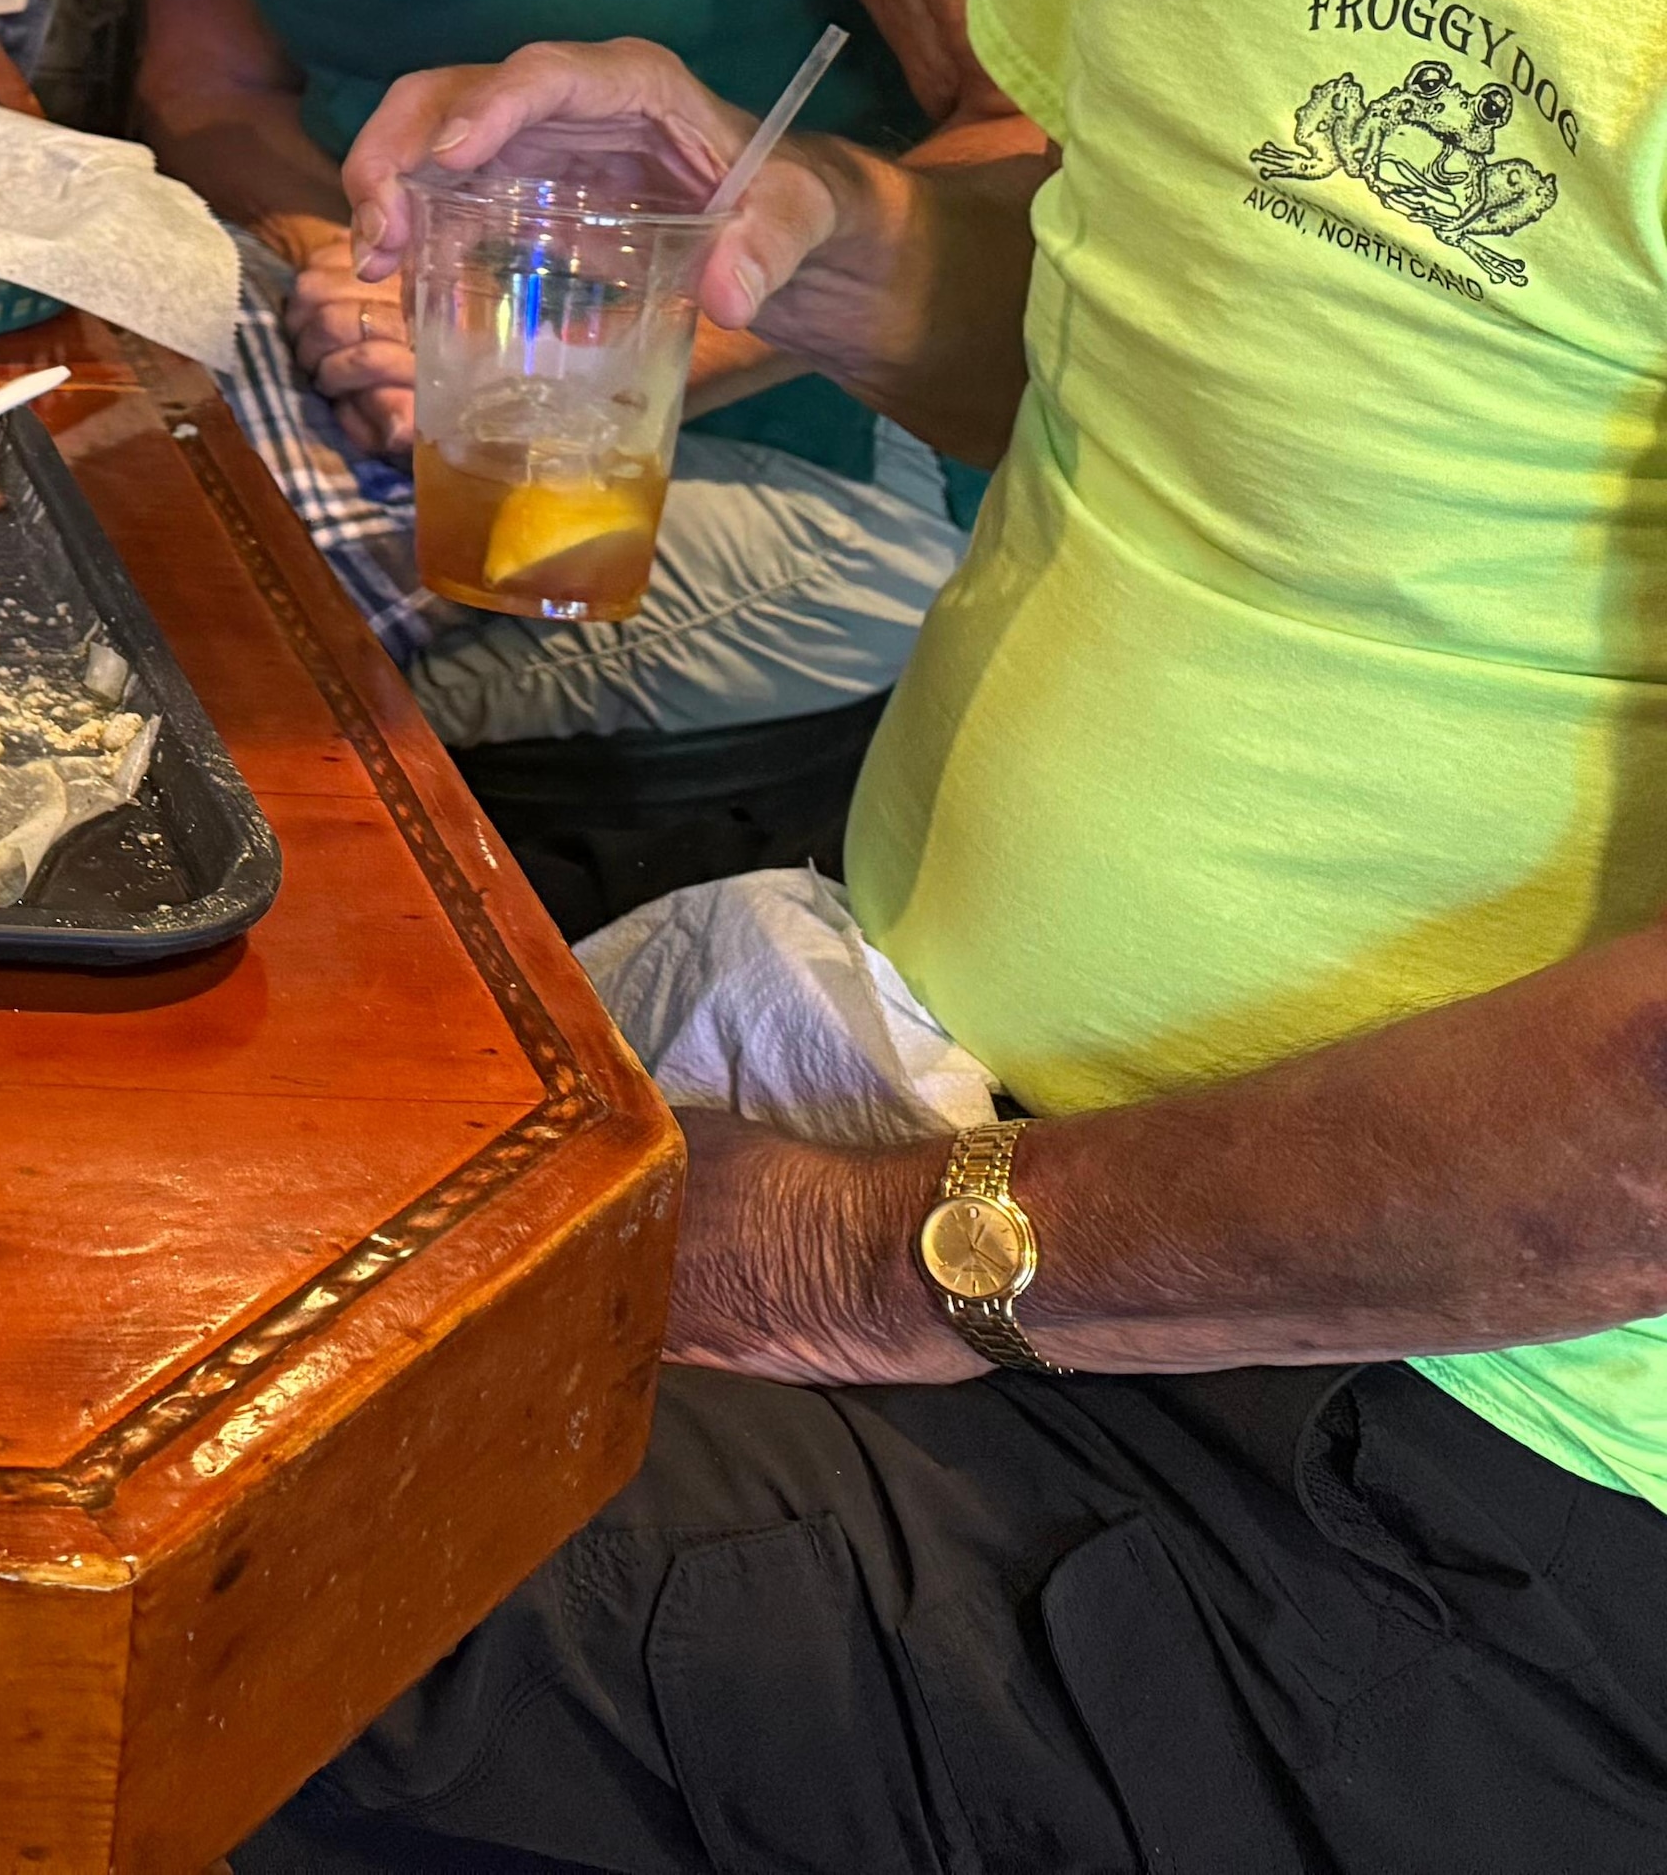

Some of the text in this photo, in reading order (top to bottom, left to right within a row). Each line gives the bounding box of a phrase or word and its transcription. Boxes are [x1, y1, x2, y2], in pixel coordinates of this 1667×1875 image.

[1511, 46, 1581, 157] DOG
[1242, 186, 1485, 302] AVON, NORTH CARO
